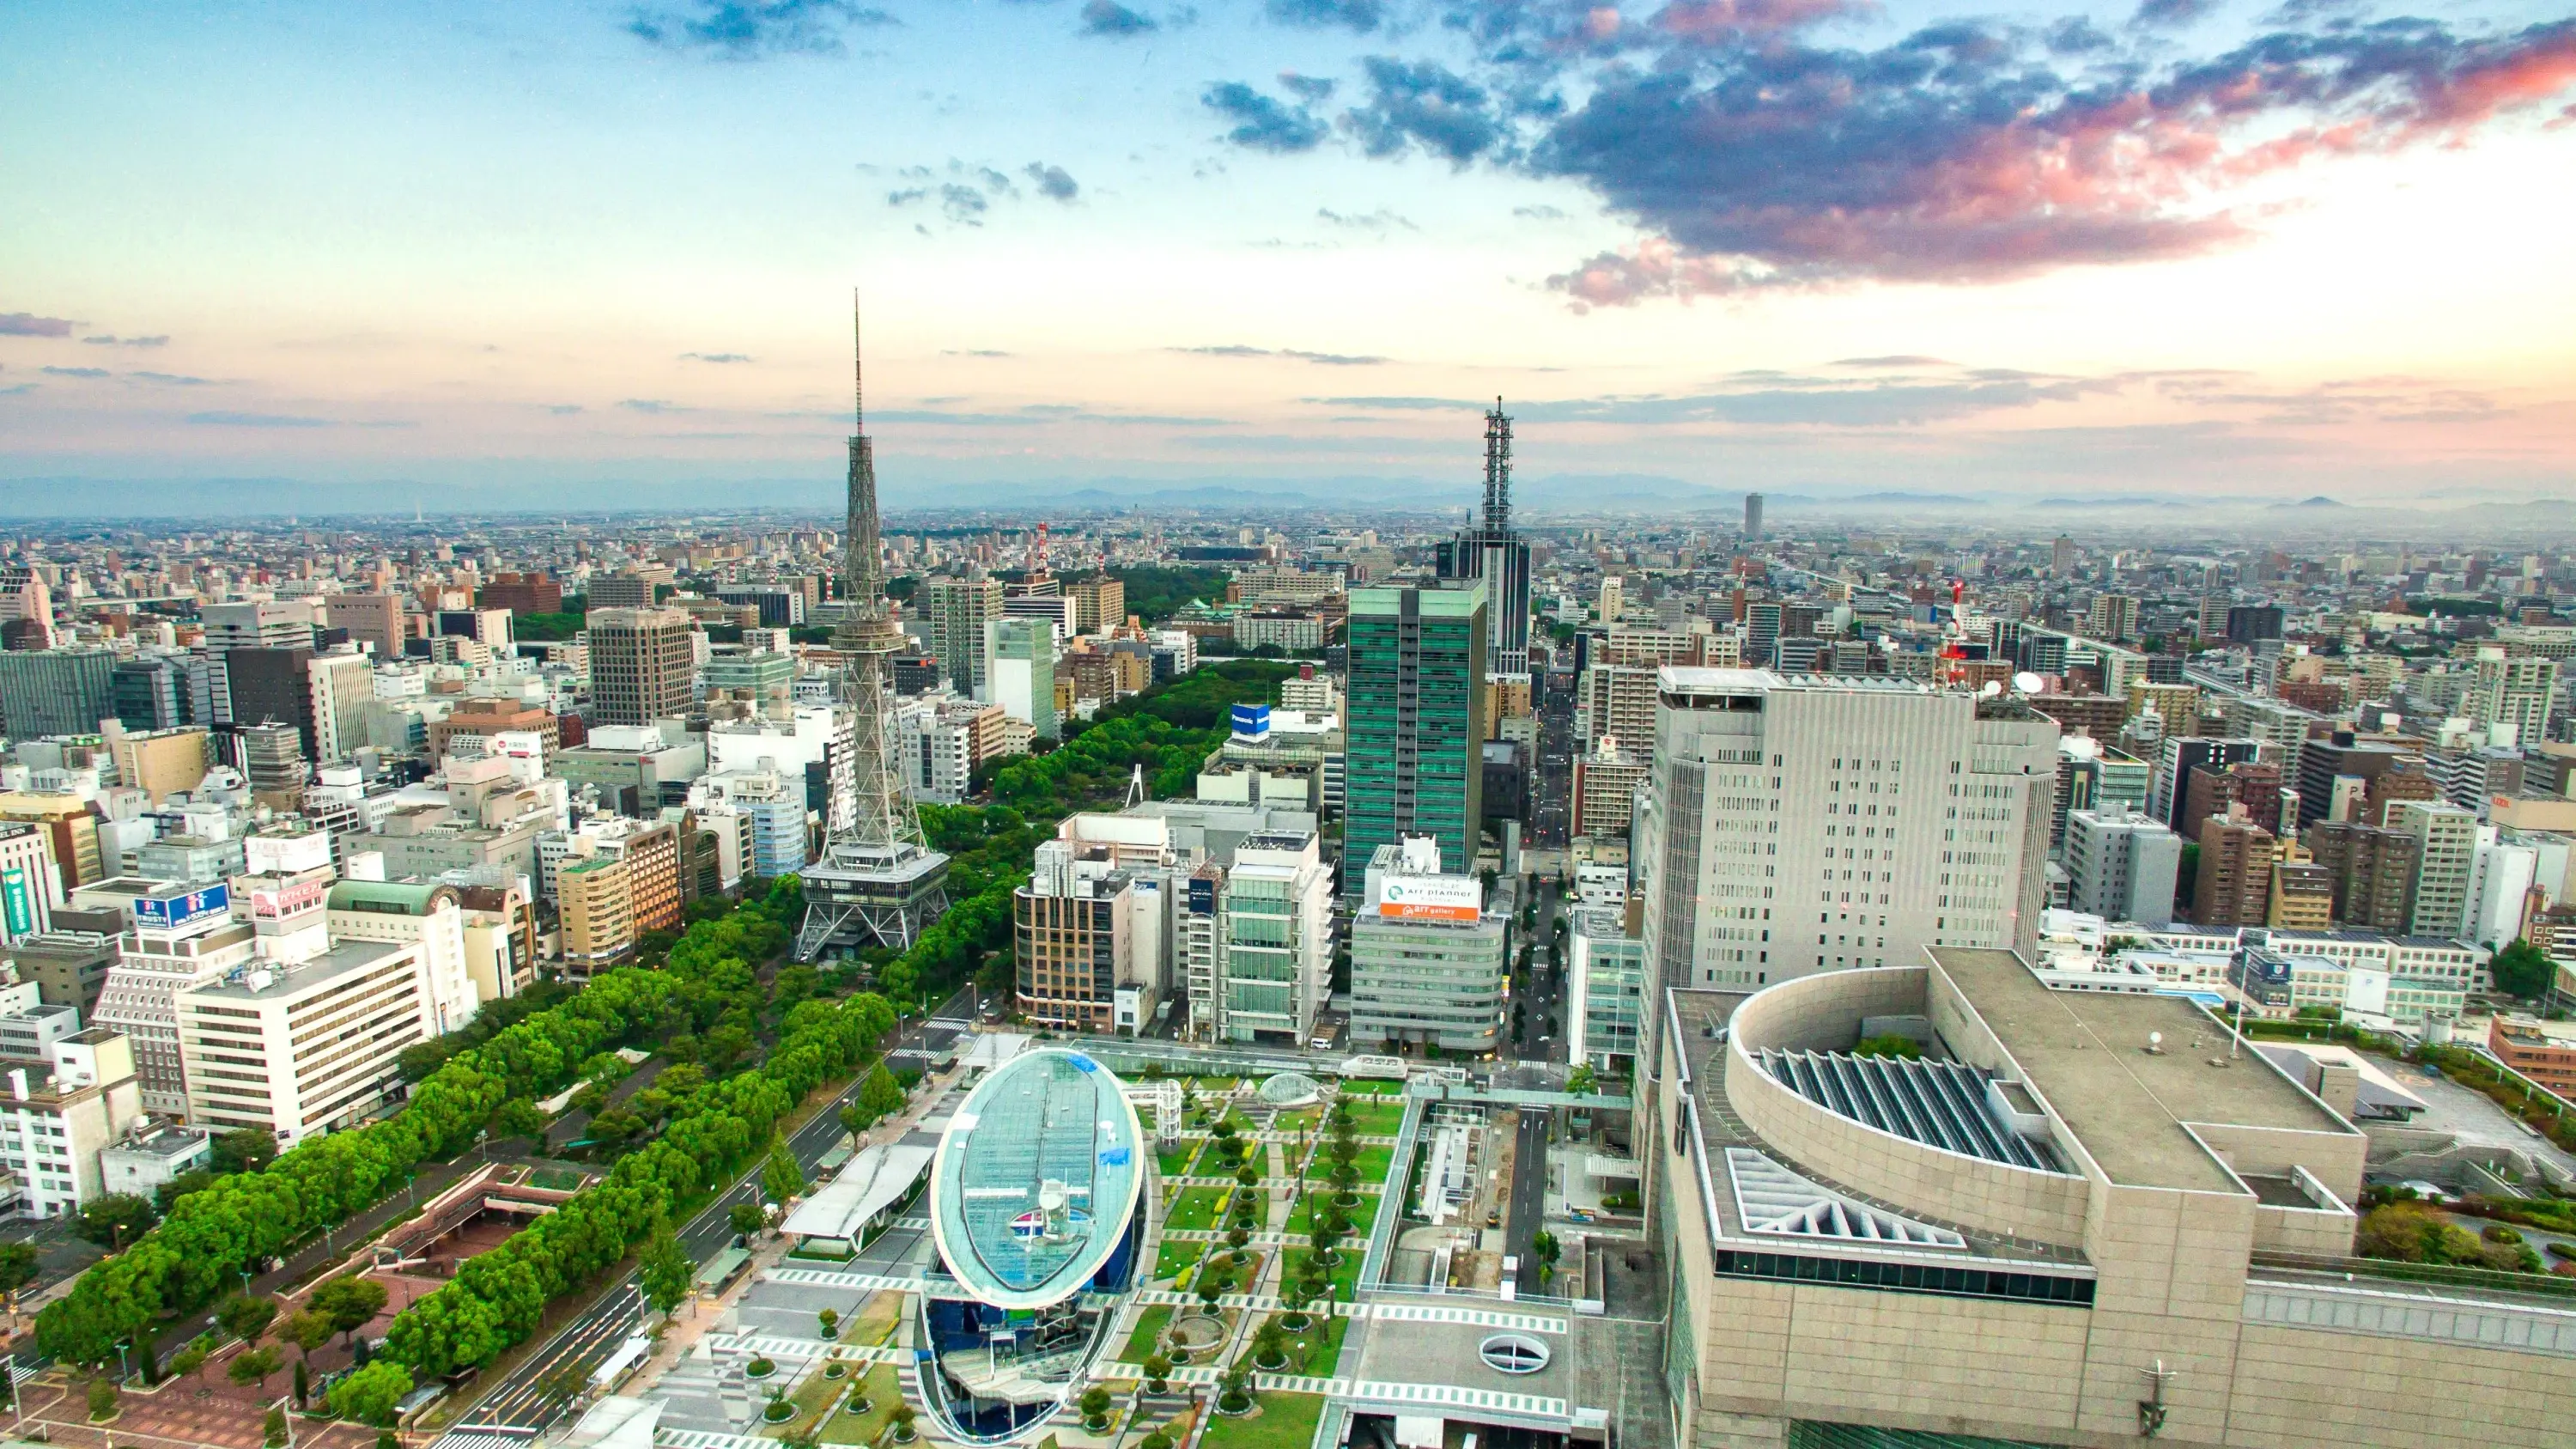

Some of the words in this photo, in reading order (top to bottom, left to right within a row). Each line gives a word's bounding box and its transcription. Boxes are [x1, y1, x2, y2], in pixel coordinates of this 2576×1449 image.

[2350, 786, 2359, 795] P
[11, 827, 26, 836] INN
[137, 914, 167, 923] TRUSTY
